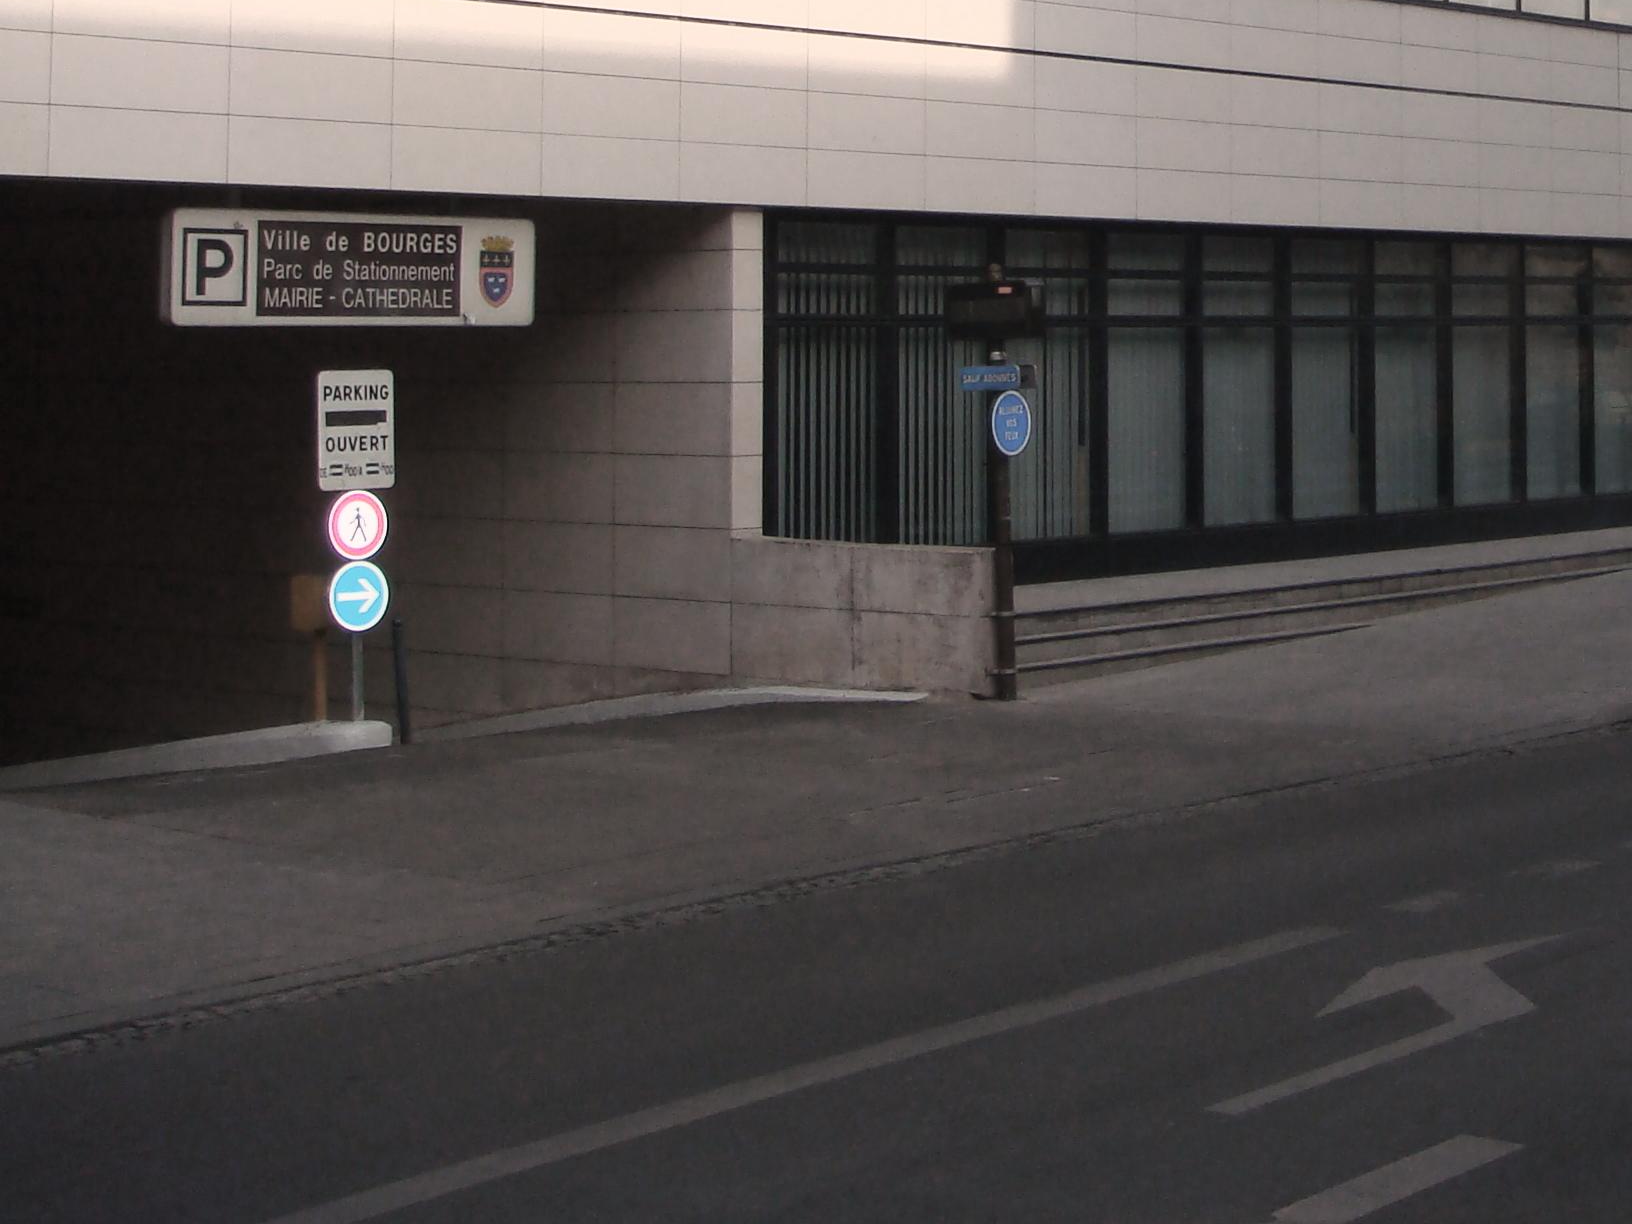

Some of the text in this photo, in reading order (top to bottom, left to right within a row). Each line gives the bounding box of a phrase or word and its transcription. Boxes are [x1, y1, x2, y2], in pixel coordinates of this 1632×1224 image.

[264, 229, 458, 254] Ville de BOURGES
[195, 238, 234, 297] P
[263, 259, 455, 283] Parc de Stationnement
[264, 287, 324, 308] MAIRIE
[341, 288, 453, 310] CATHEDRALE
[322, 383, 390, 402] PARKING
[325, 435, 389, 453] OUVERT
